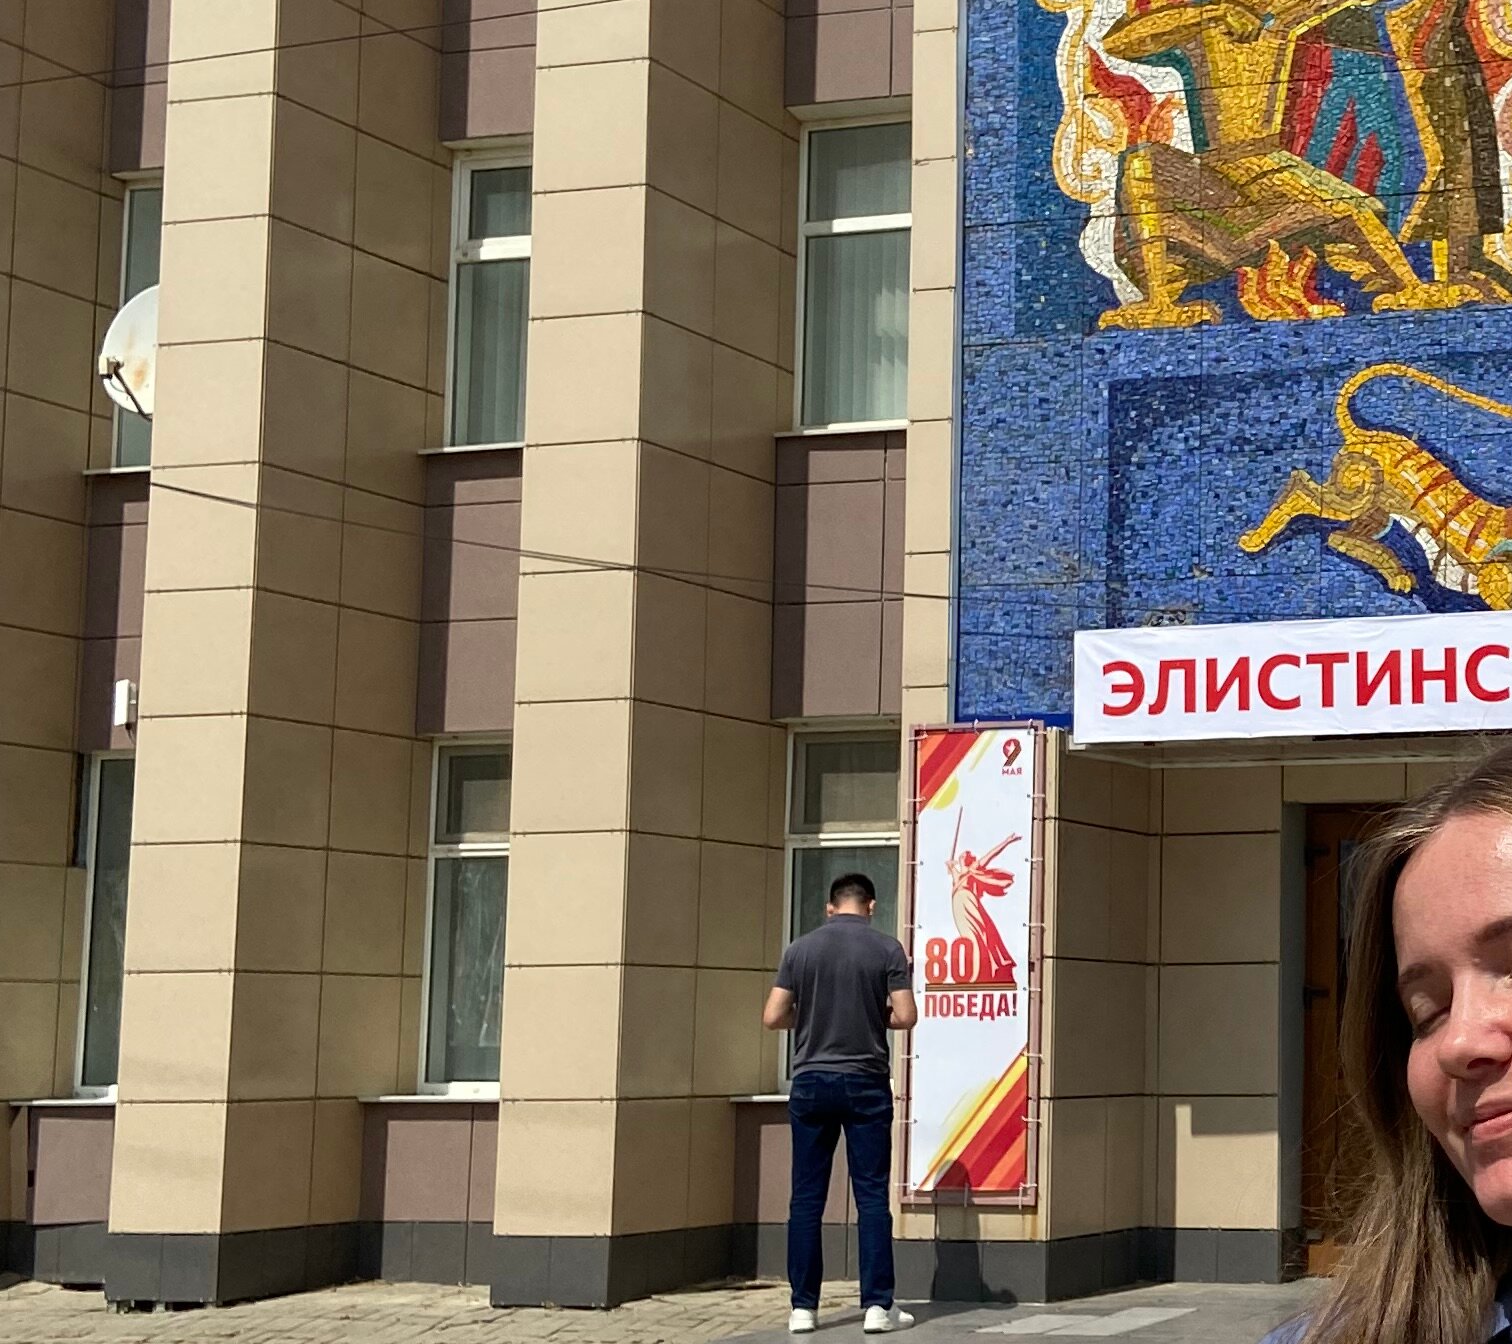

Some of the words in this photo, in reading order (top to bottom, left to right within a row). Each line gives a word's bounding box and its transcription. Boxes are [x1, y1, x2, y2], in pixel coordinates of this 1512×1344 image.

[1002, 738, 1022, 767] 9
[1001, 767, 1022, 776] МАЯ
[925, 936, 974, 984] 80
[924, 993, 1018, 1021] ПОБЕДА!
